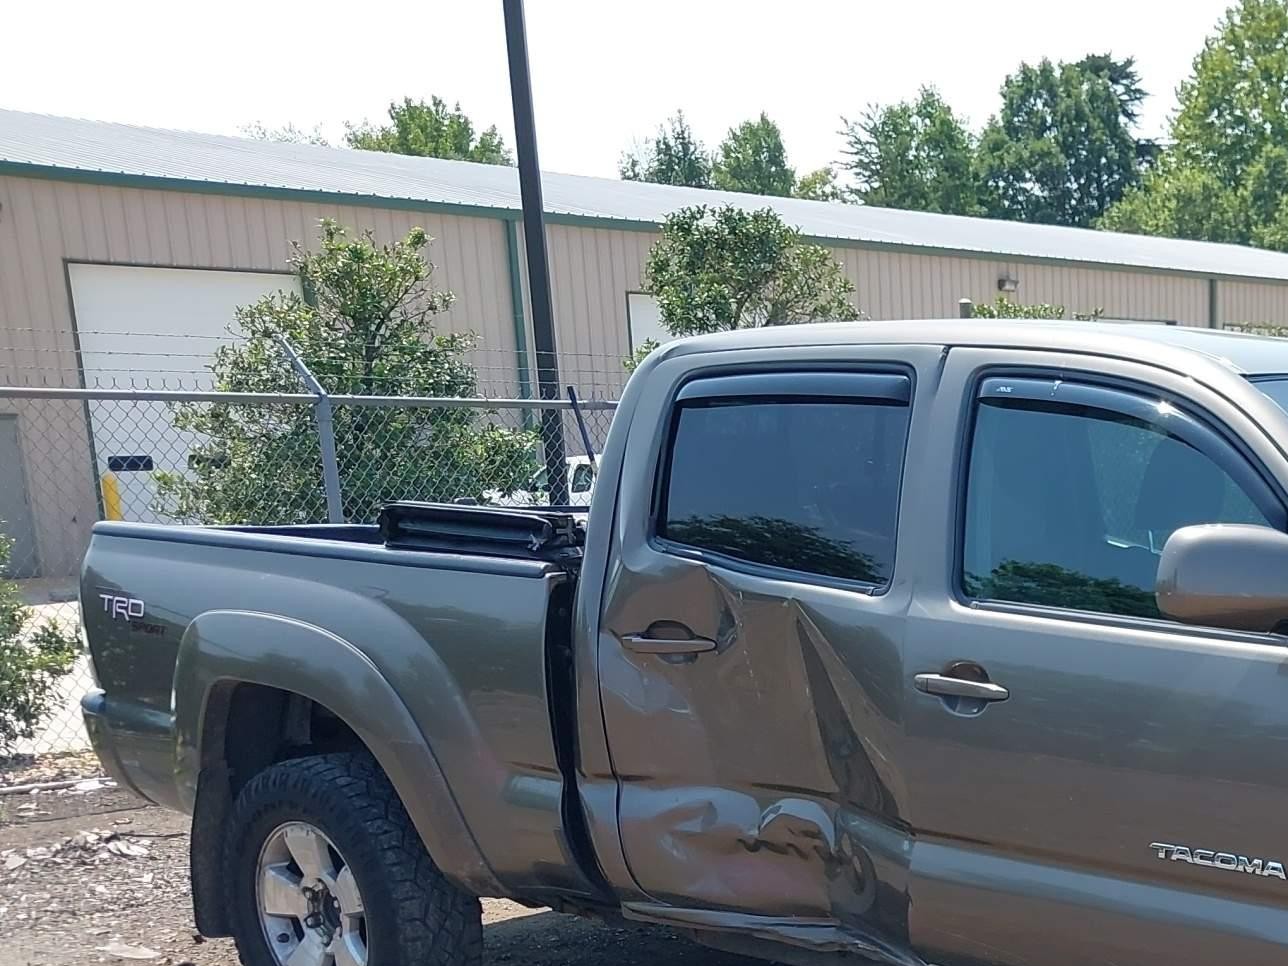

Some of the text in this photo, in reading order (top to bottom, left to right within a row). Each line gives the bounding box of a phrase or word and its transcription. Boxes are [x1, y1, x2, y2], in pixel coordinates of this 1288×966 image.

[98, 594, 145, 621] TRD
[131, 621, 168, 636] SPORT
[1149, 842, 1287, 880] TACOMA
